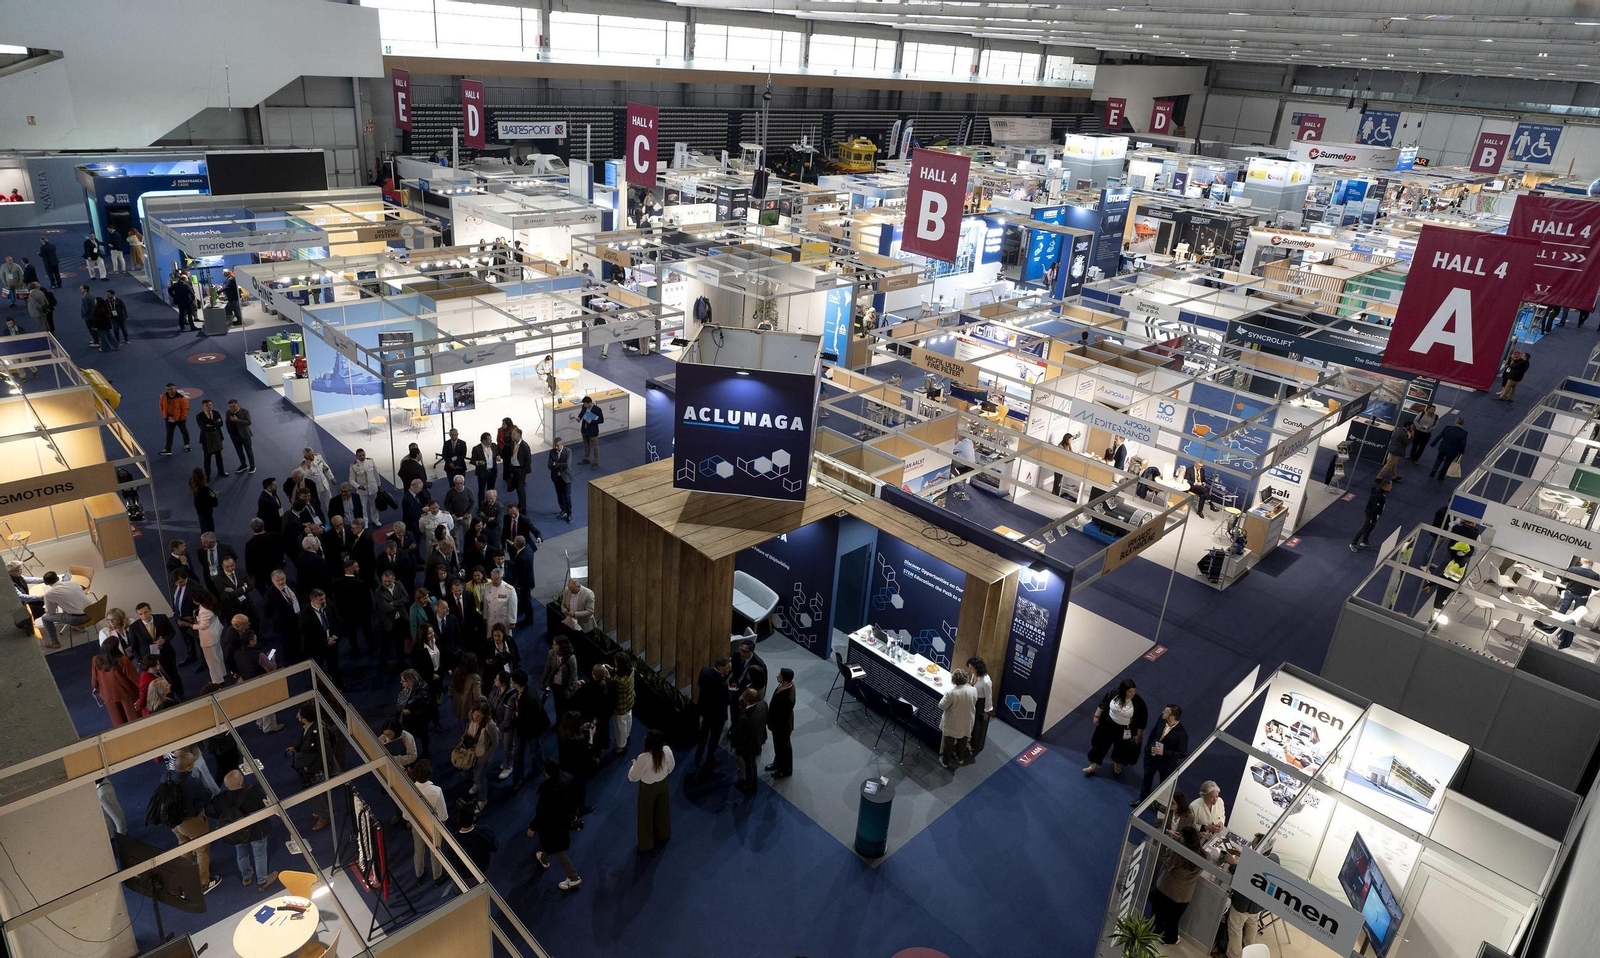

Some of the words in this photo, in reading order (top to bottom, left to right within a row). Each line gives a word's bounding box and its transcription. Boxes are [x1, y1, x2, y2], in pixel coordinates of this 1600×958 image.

[395, 79, 403, 87] HALL
[465, 90, 476, 99] HALL
[398, 92, 407, 122] E
[468, 104, 480, 137] D
[632, 116, 648, 128] HALL
[648, 119, 653, 129] 4
[1109, 110, 1120, 126] E
[1154, 113, 1166, 129] D
[634, 134, 650, 174] C
[1320, 151, 1356, 162] Sumelga
[1479, 148, 1497, 167] B
[920, 166, 947, 183] HALL
[950, 173, 957, 185] 4
[917, 190, 948, 241] B
[1531, 219, 1575, 237] HALL
[1580, 225, 1592, 238] 4
[199, 241, 244, 251] mareche
[1283, 238, 1315, 248] Sumelga
[1432, 251, 1486, 276] HALL
[1494, 262, 1508, 279] 4
[258, 286, 274, 305] HINE
[1139, 302, 1159, 310] Termika
[1409, 287, 1473, 364] A
[925, 354, 944, 366] MICFIL
[946, 362, 964, 372] ULTRA
[927, 362, 940, 370] FINE
[941, 366, 960, 377] FILTER
[1156, 413, 1172, 422] AÑOS
[1157, 401, 1175, 416] 50
[684, 406, 804, 431] ACLUNAGA
[1128, 536, 1138, 547] VAN
[1139, 528, 1152, 541] AALST
[1510, 519, 1520, 527] 3L
[1522, 521, 1592, 550] INTERNACIONAL
[903, 568, 913, 577] STEM
[942, 589, 952, 598] Path
[921, 568, 949, 586] Opportunities
[1014, 618, 1045, 636] ACLUNAGA
[1280, 692, 1344, 730] aimen
[1244, 797, 1264, 812] Building
[1251, 872, 1339, 935] aimen
[1285, 907, 1315, 928] TECHNOLOGY
[1316, 926, 1335, 940] CENTRE
